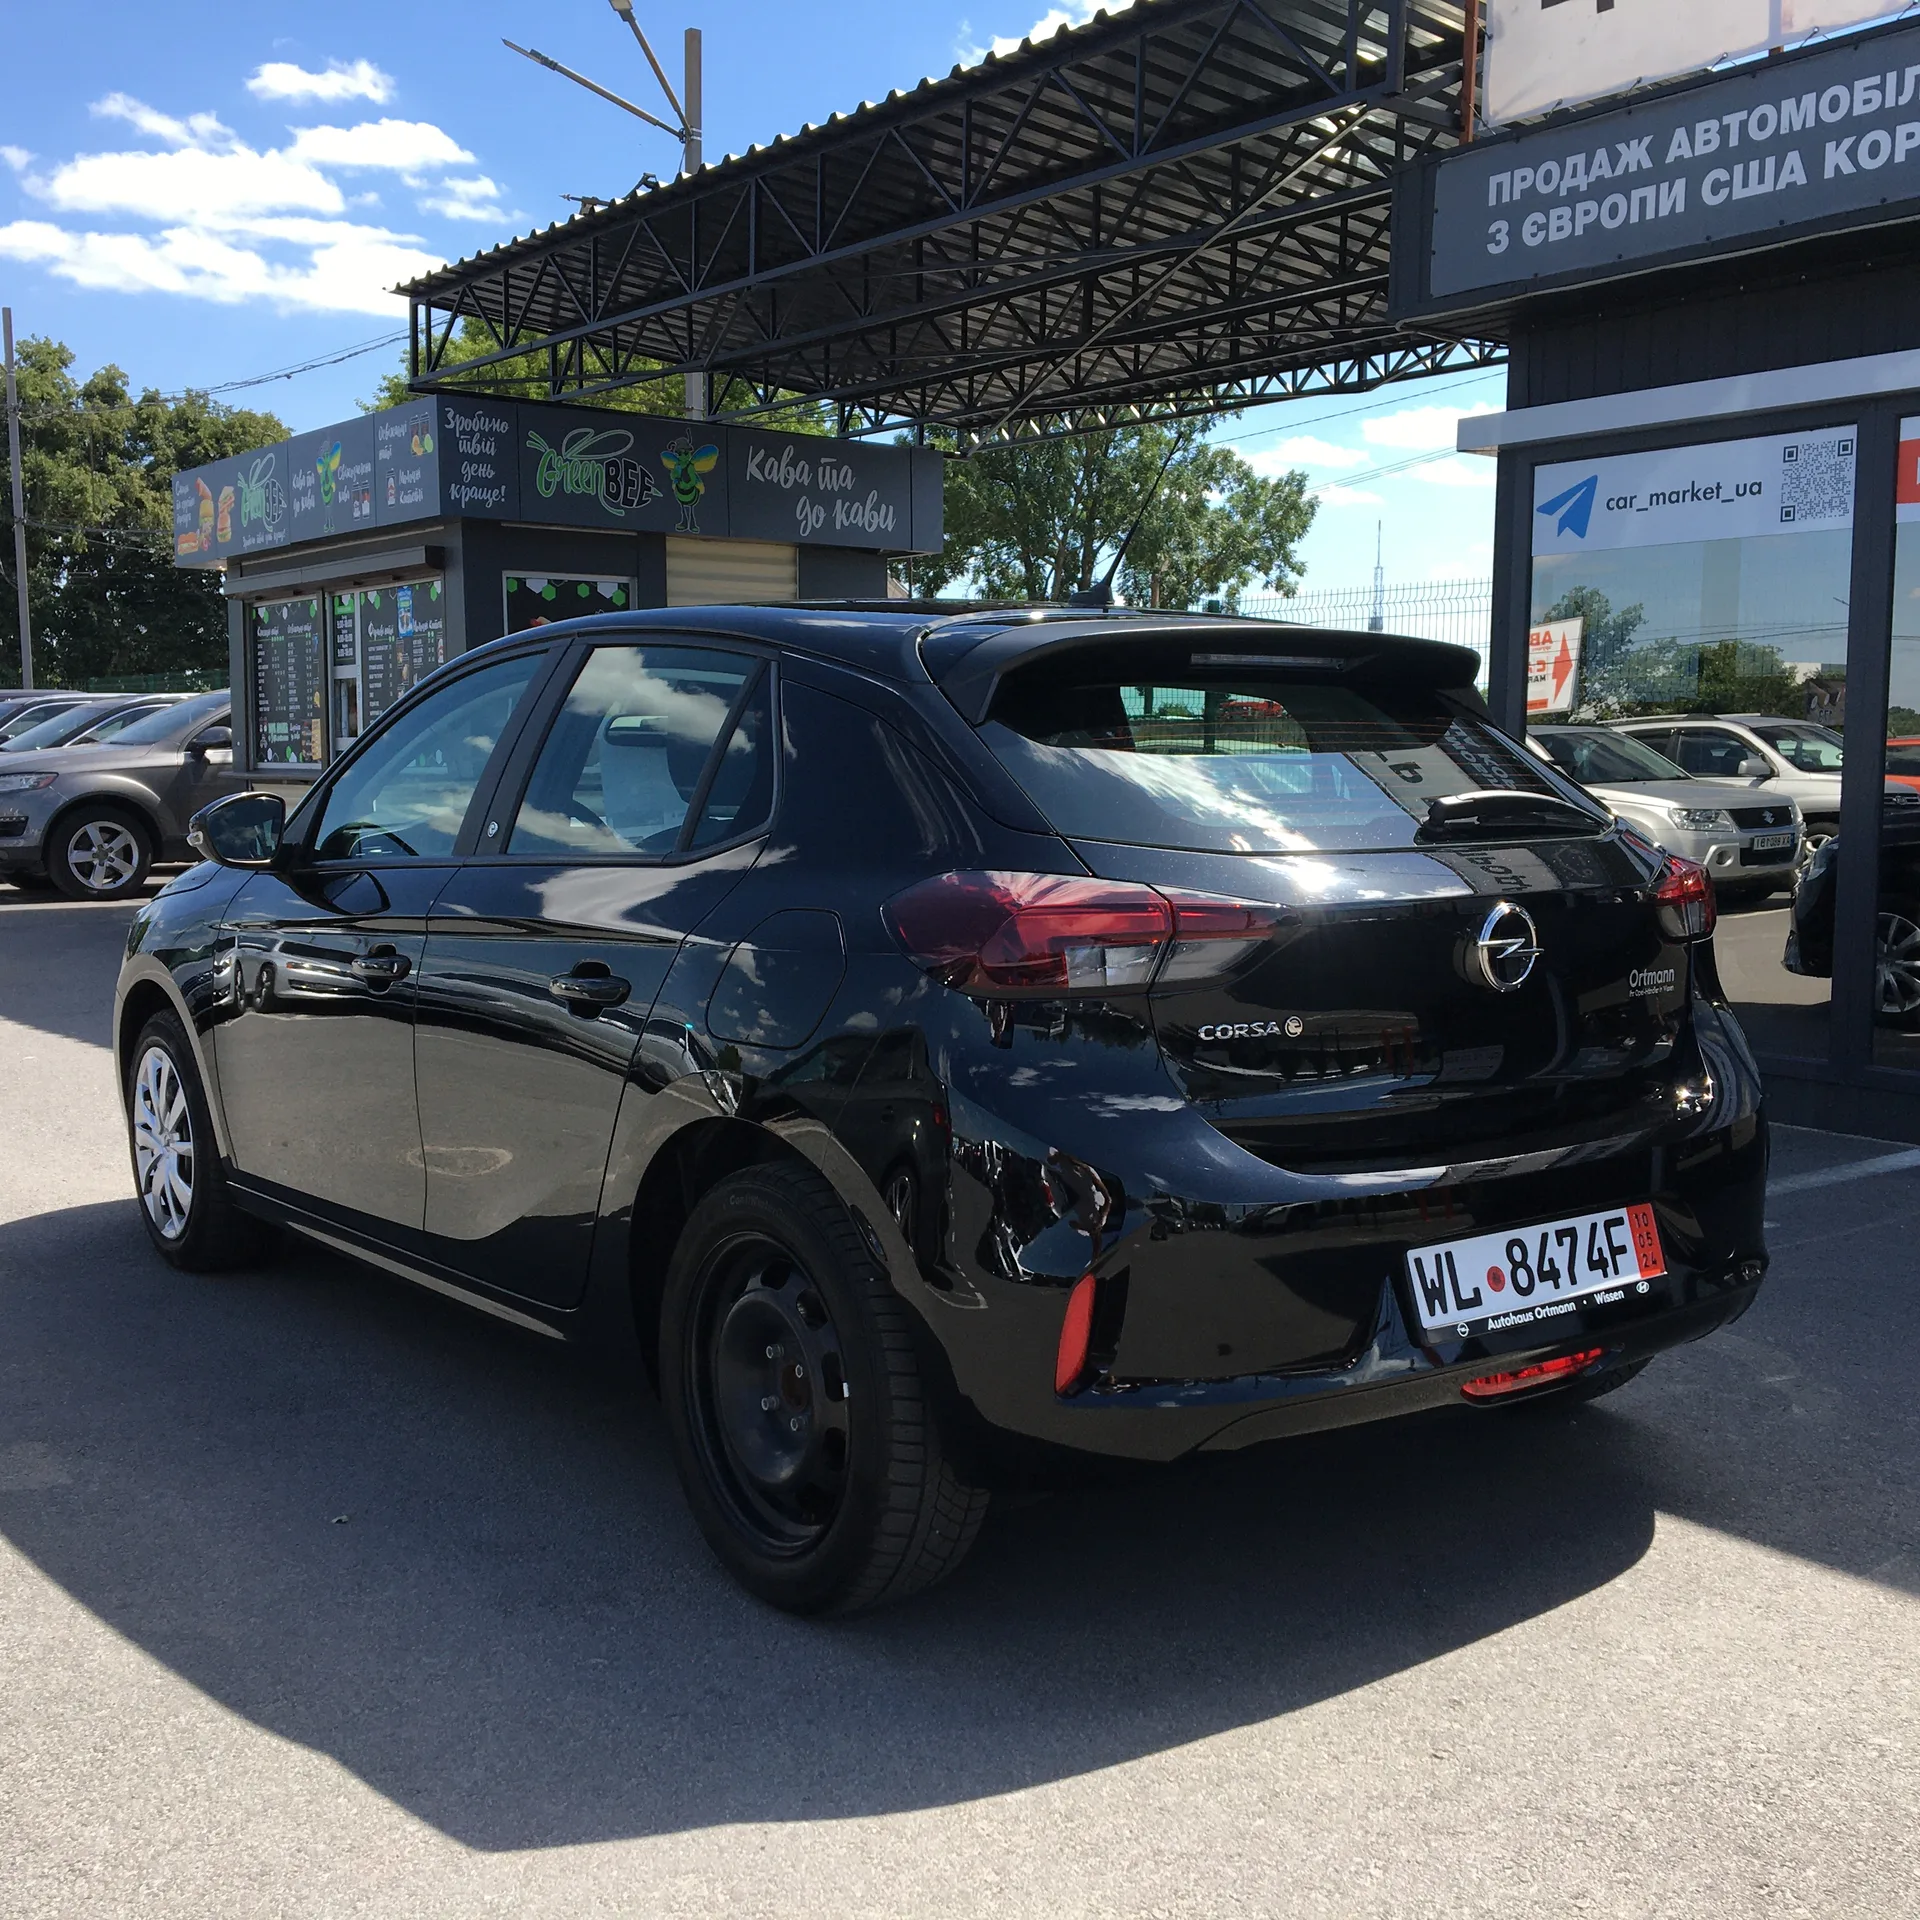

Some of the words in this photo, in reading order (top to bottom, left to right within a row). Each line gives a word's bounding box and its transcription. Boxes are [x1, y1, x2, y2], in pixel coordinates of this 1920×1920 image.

[1488, 135, 1654, 207] ПРОДАЖ
[1521, 178, 1687, 248] ЄВРОПИ
[1700, 150, 1808, 206] США
[1823, 121, 1920, 180] КОР
[444, 407, 509, 438] Зробимо
[458, 432, 497, 456] твій
[461, 461, 496, 483] день
[746, 444, 814, 489] Кава
[817, 457, 857, 492] та
[448, 483, 507, 509] краще!
[1605, 480, 1763, 513] car_market_ua
[795, 495, 827, 537] до
[831, 489, 898, 533] кави
[1629, 968, 1675, 988] Ortmann
[1197, 1021, 1281, 1041] CORSA
[1633, 1211, 1649, 1229] 10
[1637, 1231, 1653, 1249] 05
[1641, 1251, 1658, 1269] 24
[1413, 1250, 1483, 1317] WL
[1487, 1310, 1534, 1331] Autohaus
[1534, 1301, 1577, 1319] Ortmann
[1593, 1289, 1625, 1306] Wissen
